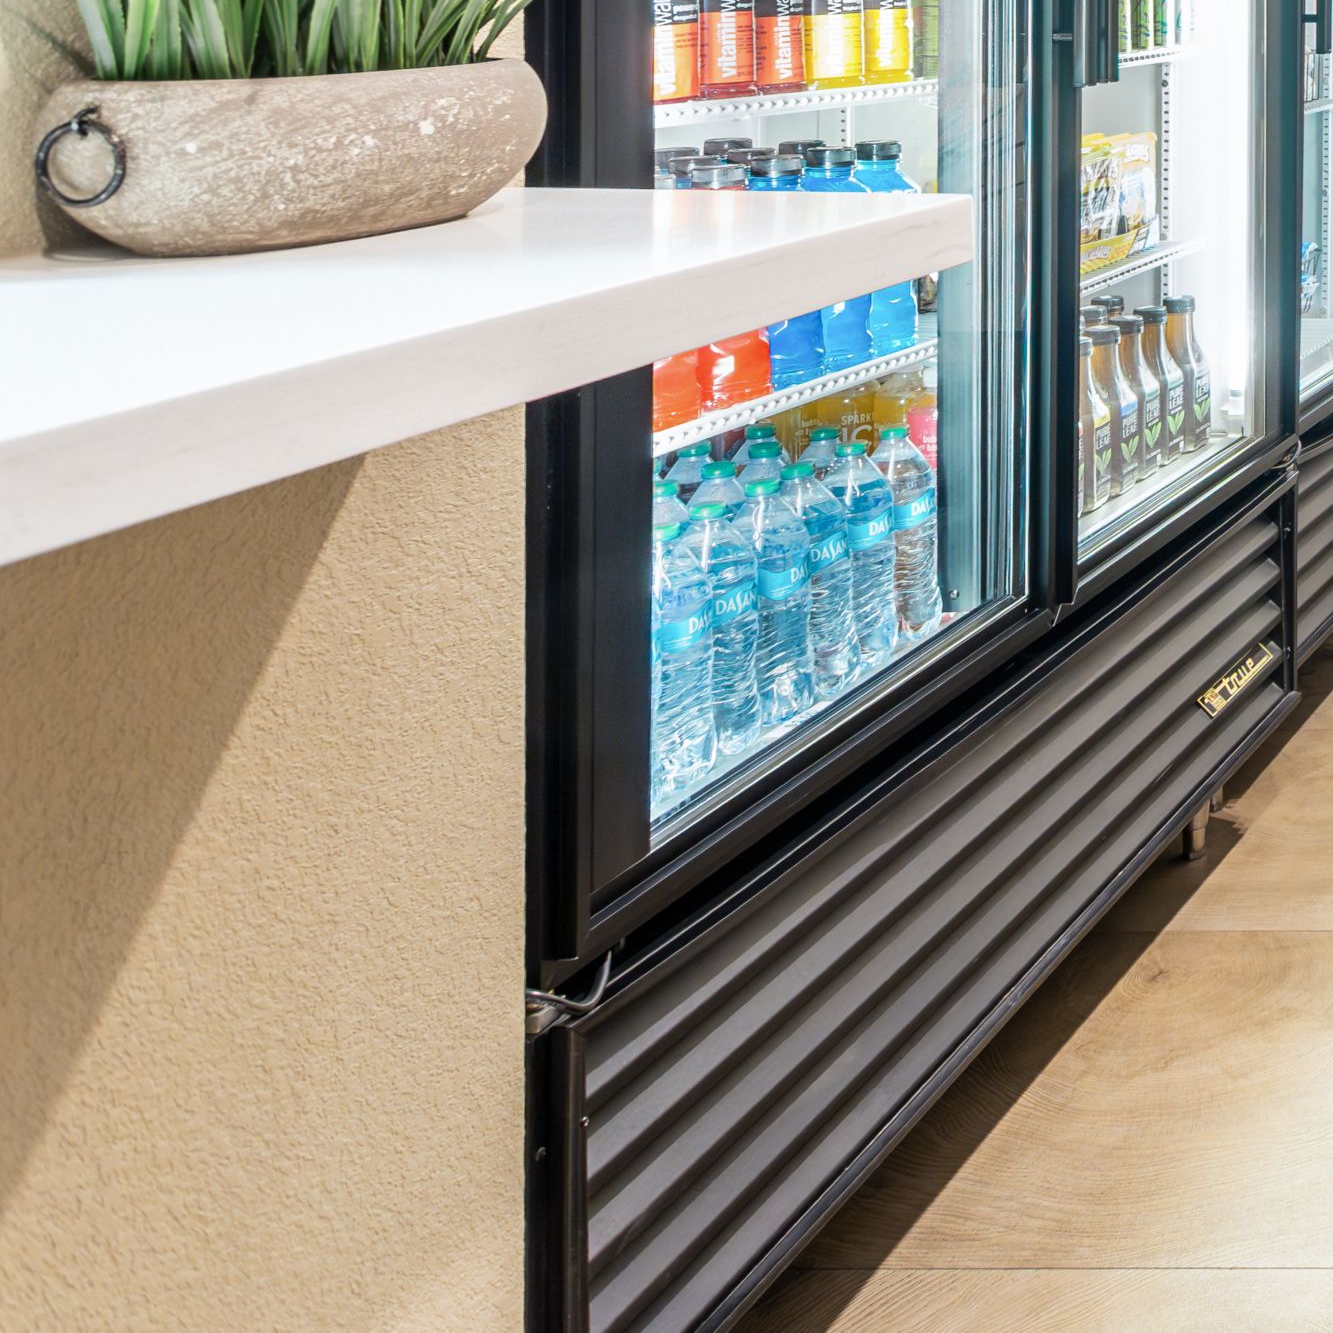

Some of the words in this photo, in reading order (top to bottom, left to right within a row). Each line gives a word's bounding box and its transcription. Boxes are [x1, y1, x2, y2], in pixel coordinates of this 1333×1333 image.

[1170, 386, 1184, 400] PURE
[1169, 397, 1184, 410] LEAF
[1215, 658, 1255, 695] true
